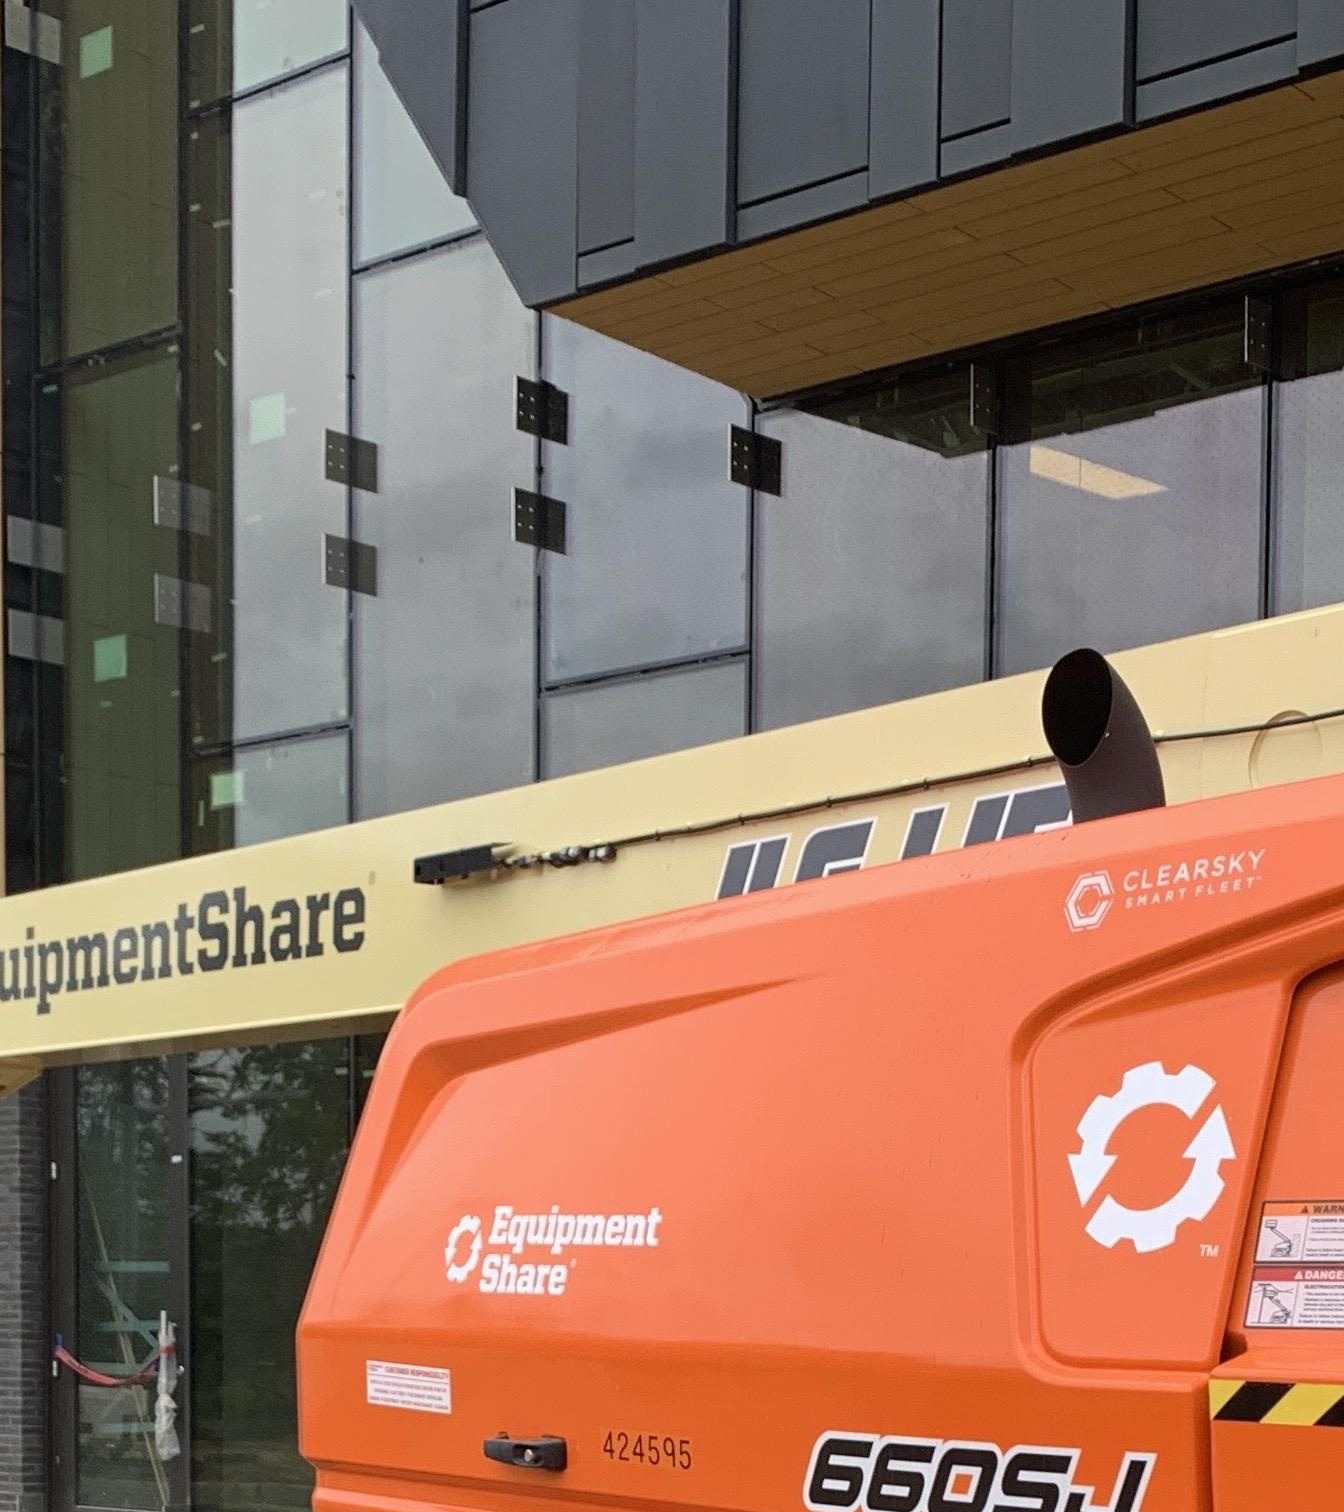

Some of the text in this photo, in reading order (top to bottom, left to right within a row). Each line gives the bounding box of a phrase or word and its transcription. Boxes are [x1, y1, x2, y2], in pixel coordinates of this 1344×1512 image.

[1122, 848, 1267, 893] CLEARSKY
[1124, 886, 1188, 910] SMART
[488, 1204, 663, 1254] Equipment
[478, 1252, 568, 1296] Share
[601, 1429, 694, 1471] 424595
